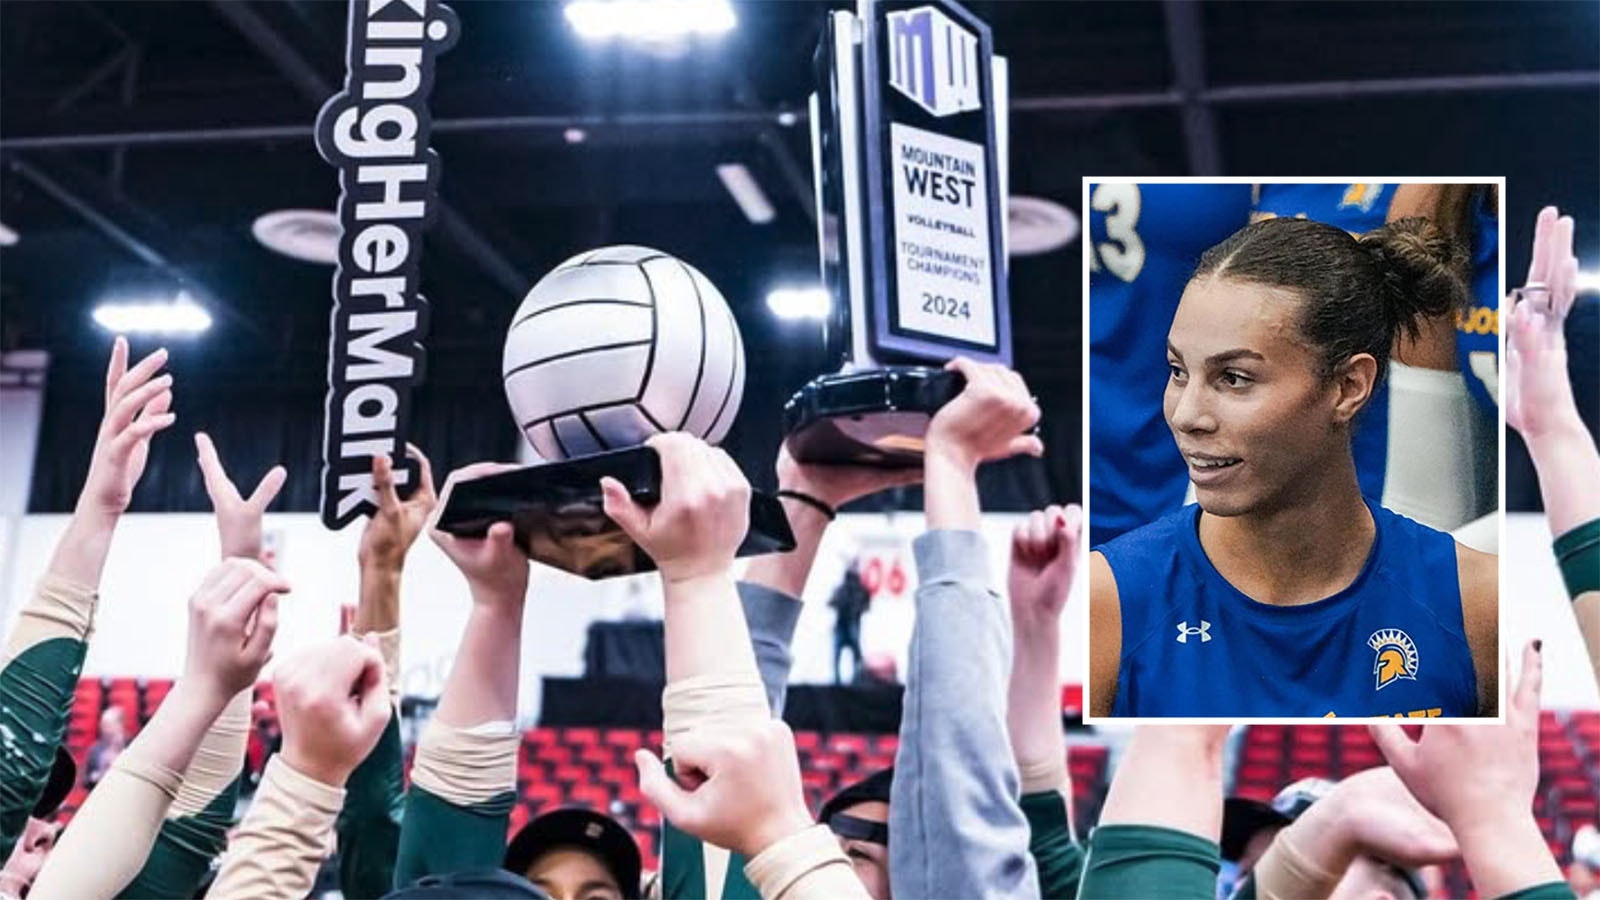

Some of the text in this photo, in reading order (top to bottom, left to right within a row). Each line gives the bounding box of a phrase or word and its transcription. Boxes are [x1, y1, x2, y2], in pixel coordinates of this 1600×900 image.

[901, 144, 976, 178] MOUNTAIN
[903, 164, 976, 208] WEST
[906, 214, 976, 238] VOLLEYBALL
[1090, 184, 1145, 283] 3
[901, 241, 985, 269] TOURNAMENT
[907, 257, 980, 285] CHAMPIONS
[921, 292, 972, 319] 2024
